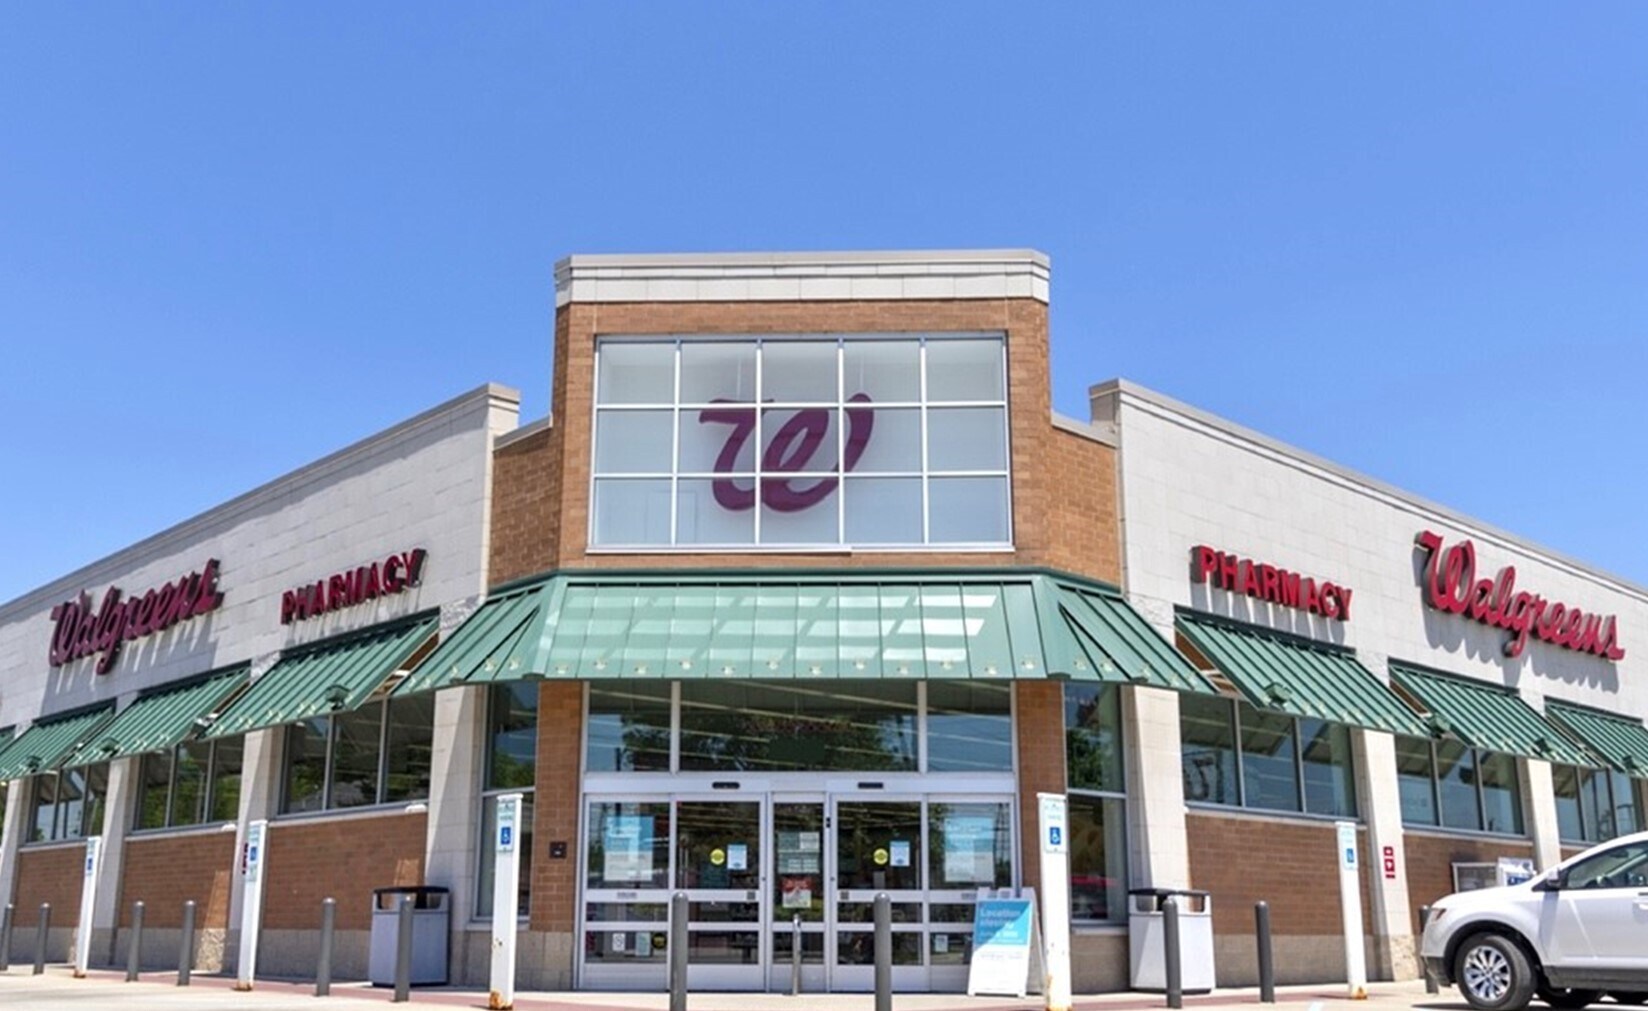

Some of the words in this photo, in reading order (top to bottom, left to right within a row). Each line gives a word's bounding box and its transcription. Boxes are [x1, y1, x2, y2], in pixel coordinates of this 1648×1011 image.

[50, 559, 224, 674] Walgreens
[282, 549, 426, 624] PHARMACY
[1192, 546, 1353, 620] PHARMACY
[1418, 530, 1625, 660] Walgreens
